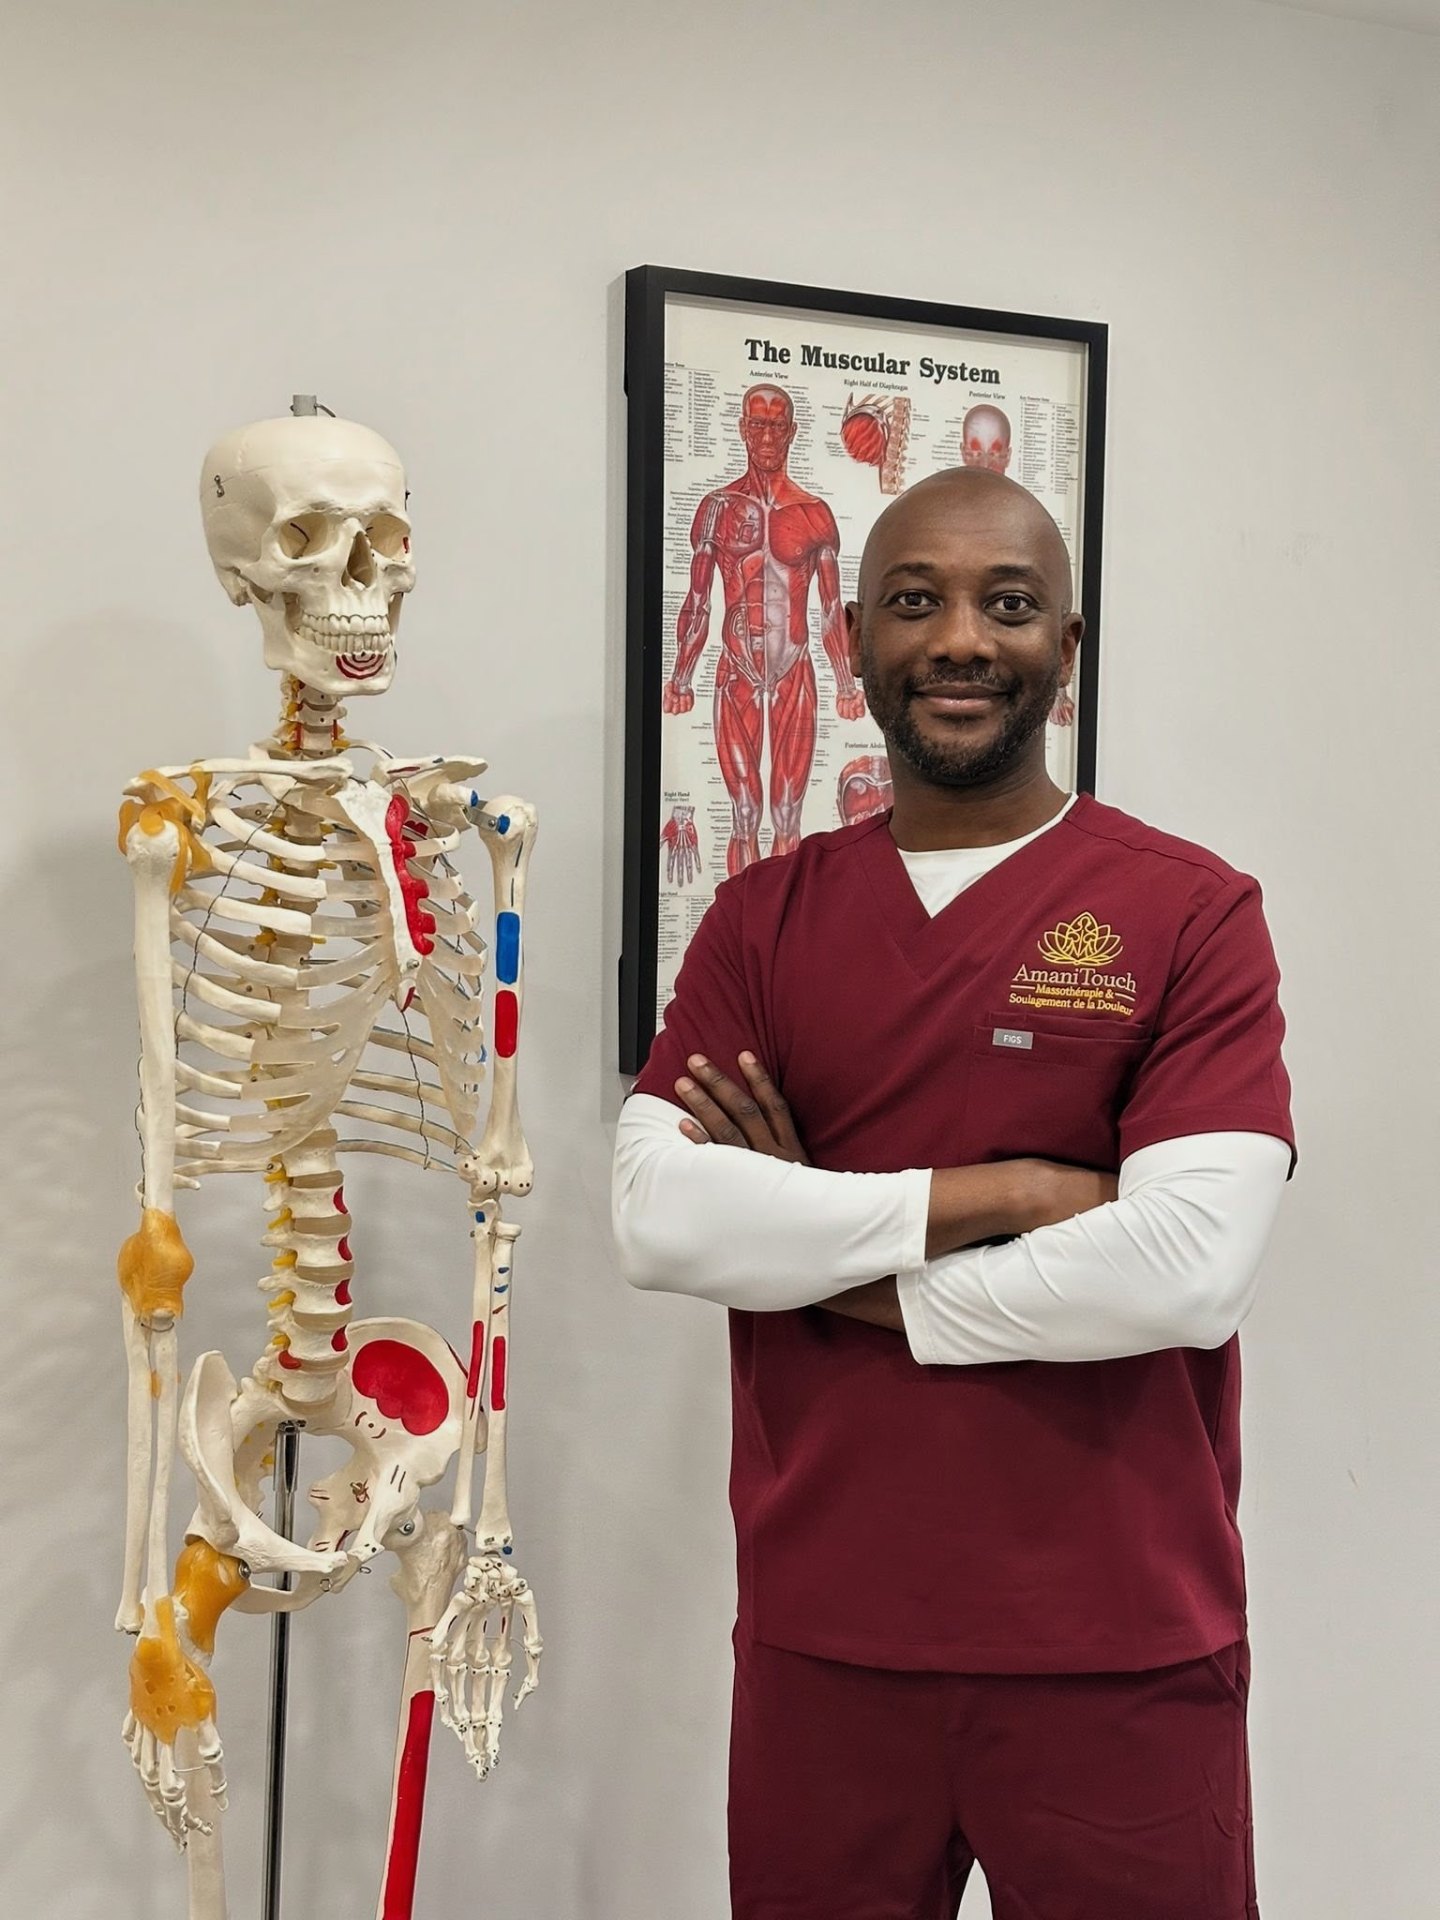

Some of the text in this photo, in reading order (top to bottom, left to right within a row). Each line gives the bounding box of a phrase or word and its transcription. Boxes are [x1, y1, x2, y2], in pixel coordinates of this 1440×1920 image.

[744, 338, 1001, 384] The Muscular System
[749, 370, 789, 380] Anterior View
[844, 379, 859, 388] Right
[860, 380, 872, 388] Half
[968, 391, 1006, 400] Posterior View
[1035, 983, 1115, 1000] Massothérapie &
[1009, 992, 1134, 1017] Soulagement de la Douleur
[1003, 1034, 1023, 1044] FIGS
